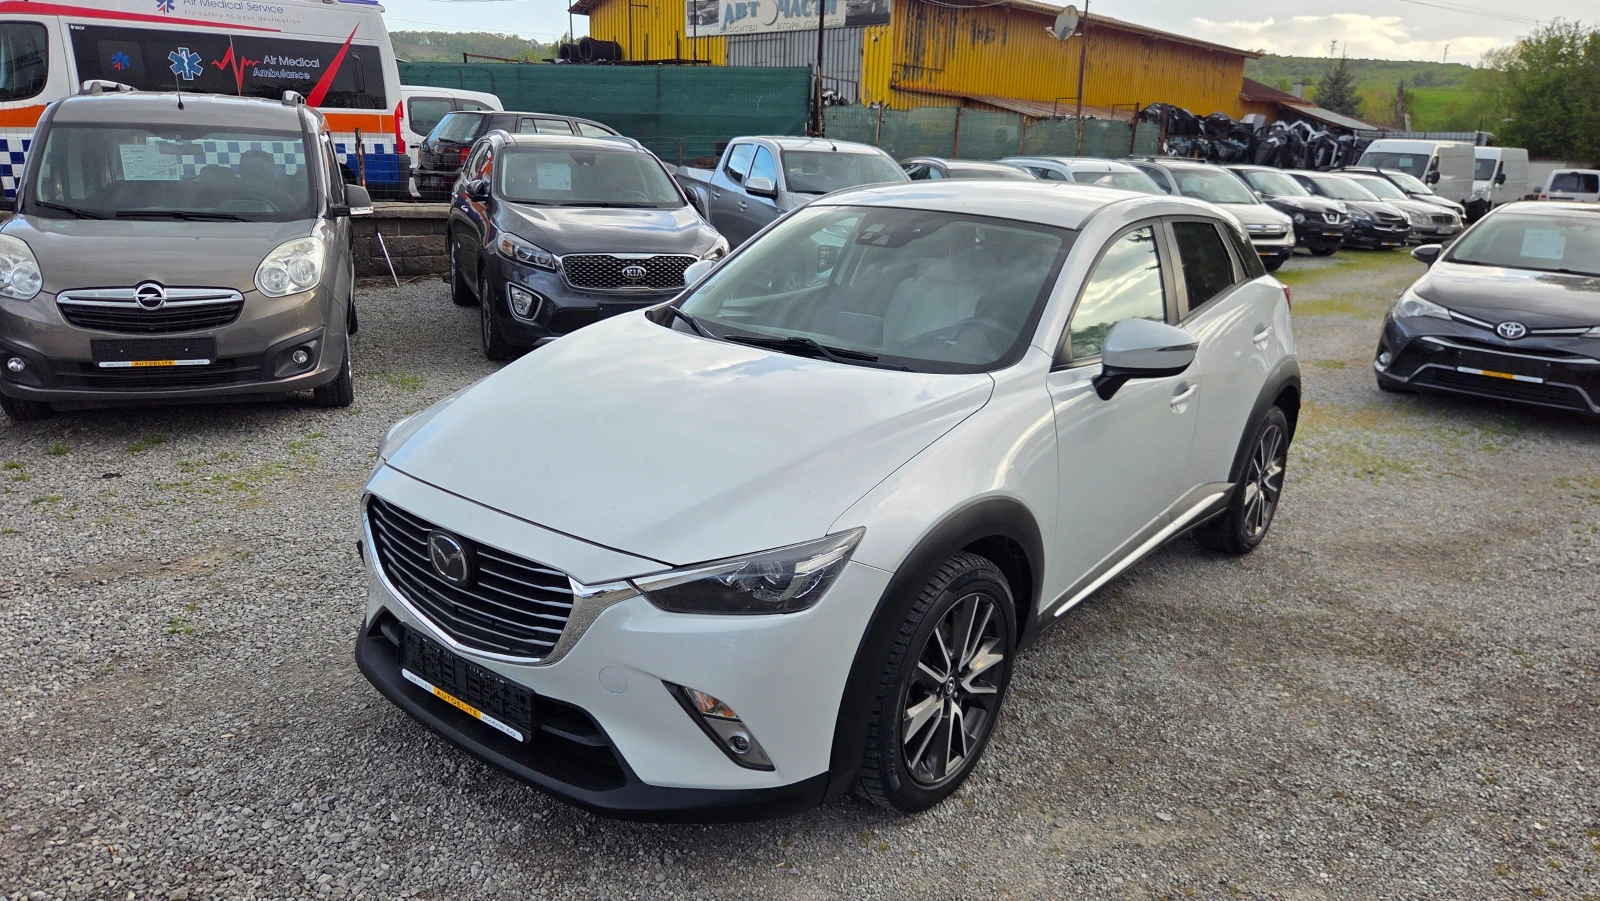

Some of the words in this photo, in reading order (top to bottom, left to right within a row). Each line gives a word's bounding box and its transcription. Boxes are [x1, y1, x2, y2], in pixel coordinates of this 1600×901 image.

[199, 0, 244, 11] Medical
[246, 2, 285, 14] Service
[199, 11, 223, 19] safely
[258, 16, 302, 25] destination
[803, 18, 844, 28] УПОРЕБА
[263, 54, 277, 65] Air
[278, 55, 320, 68] Medical
[252, 67, 311, 80] Ambulance
[626, 269, 643, 277] KIA
[436, 690, 479, 717] AUTOELITE
